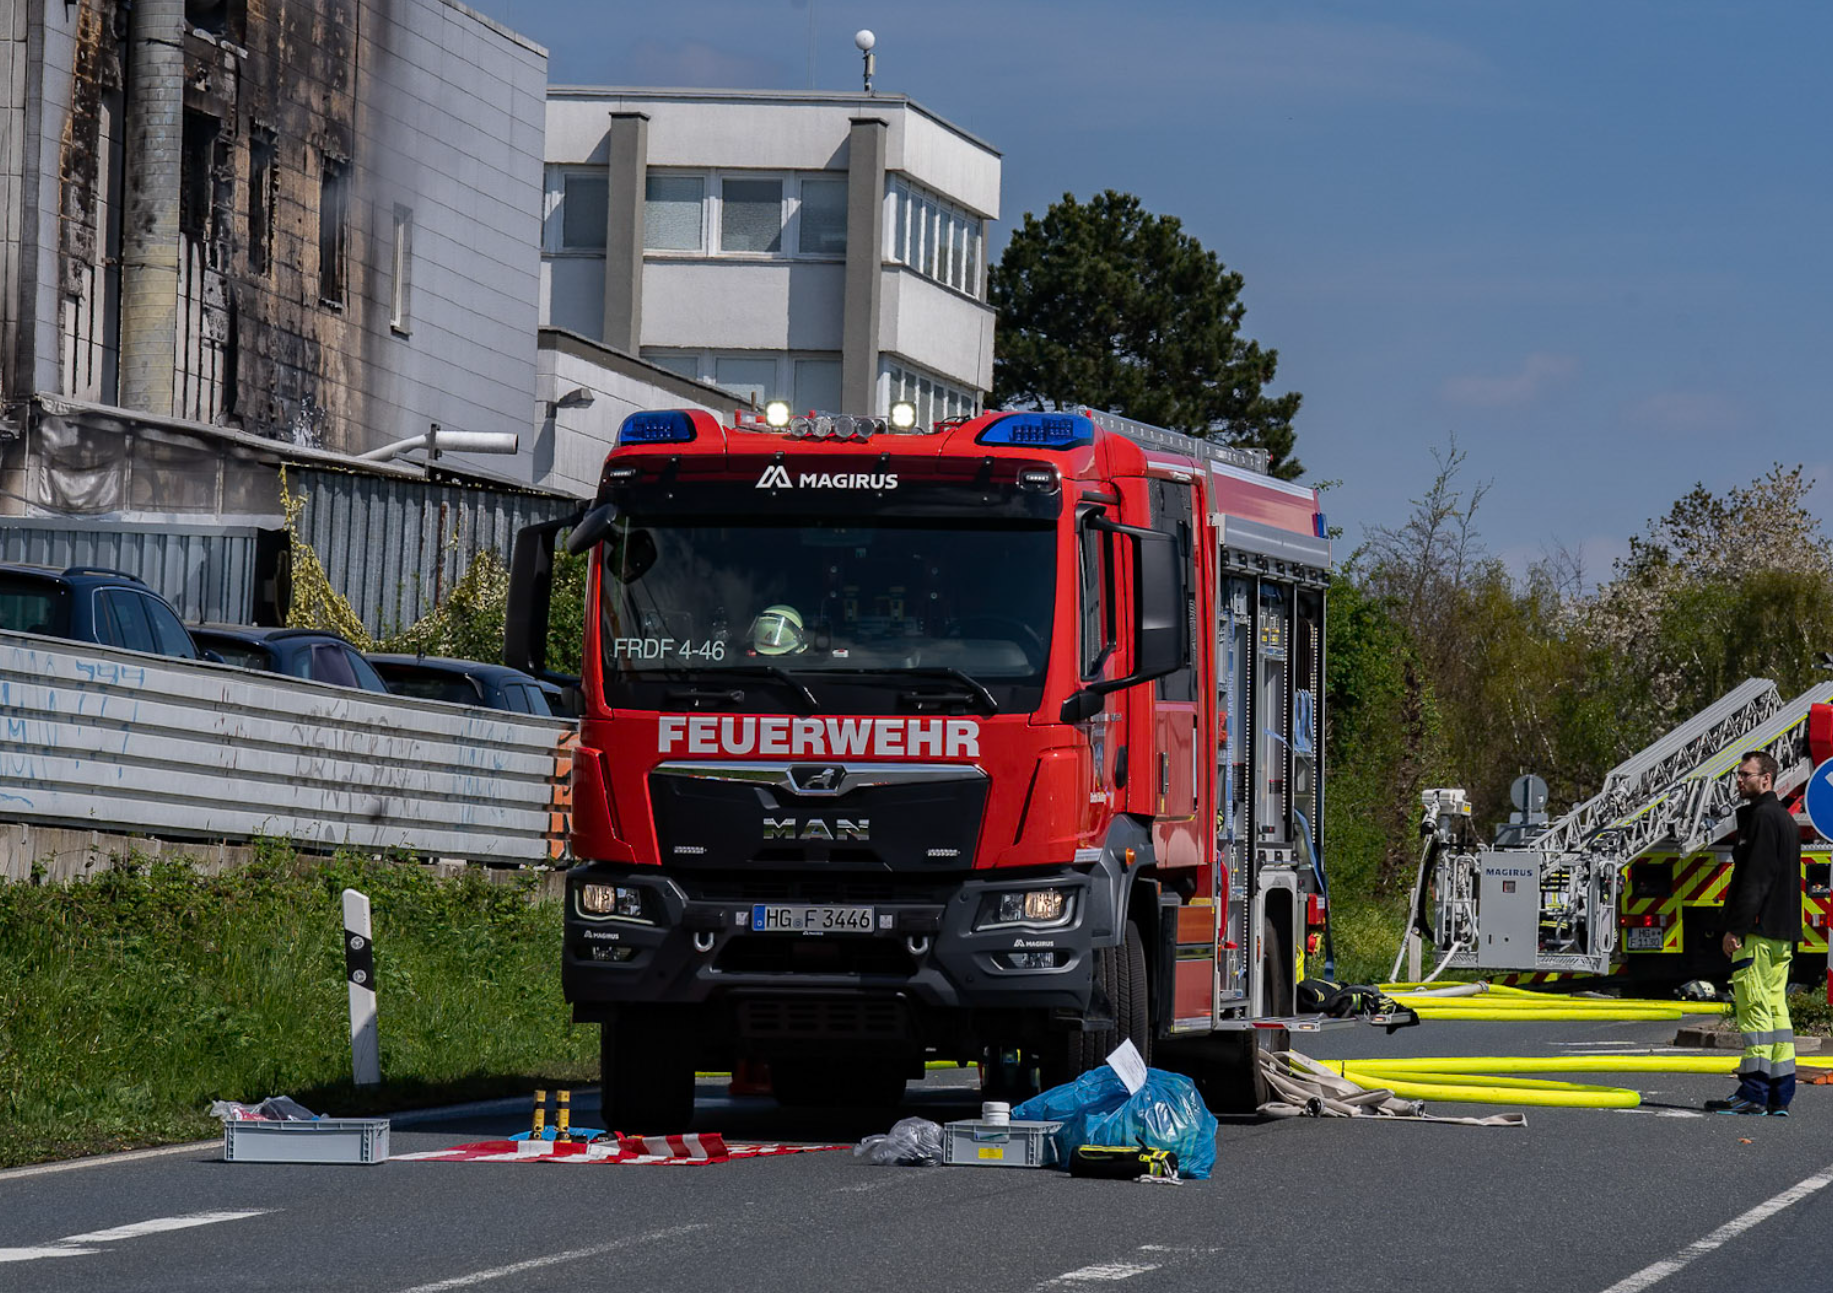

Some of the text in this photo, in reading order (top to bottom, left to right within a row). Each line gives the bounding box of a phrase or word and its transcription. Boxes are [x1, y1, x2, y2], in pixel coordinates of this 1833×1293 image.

[800, 473, 898, 489] MAGIRUS
[614, 638, 725, 661] FRDF 4-46
[658, 715, 981, 757] FEUERWEHR
[763, 818, 870, 840] MAN
[1486, 868, 1533, 877] MAGIRUS
[766, 908, 792, 928] HG
[805, 909, 817, 928] F
[822, 909, 870, 929] 3446
[1025, 940, 1054, 948] MAGIRUS
